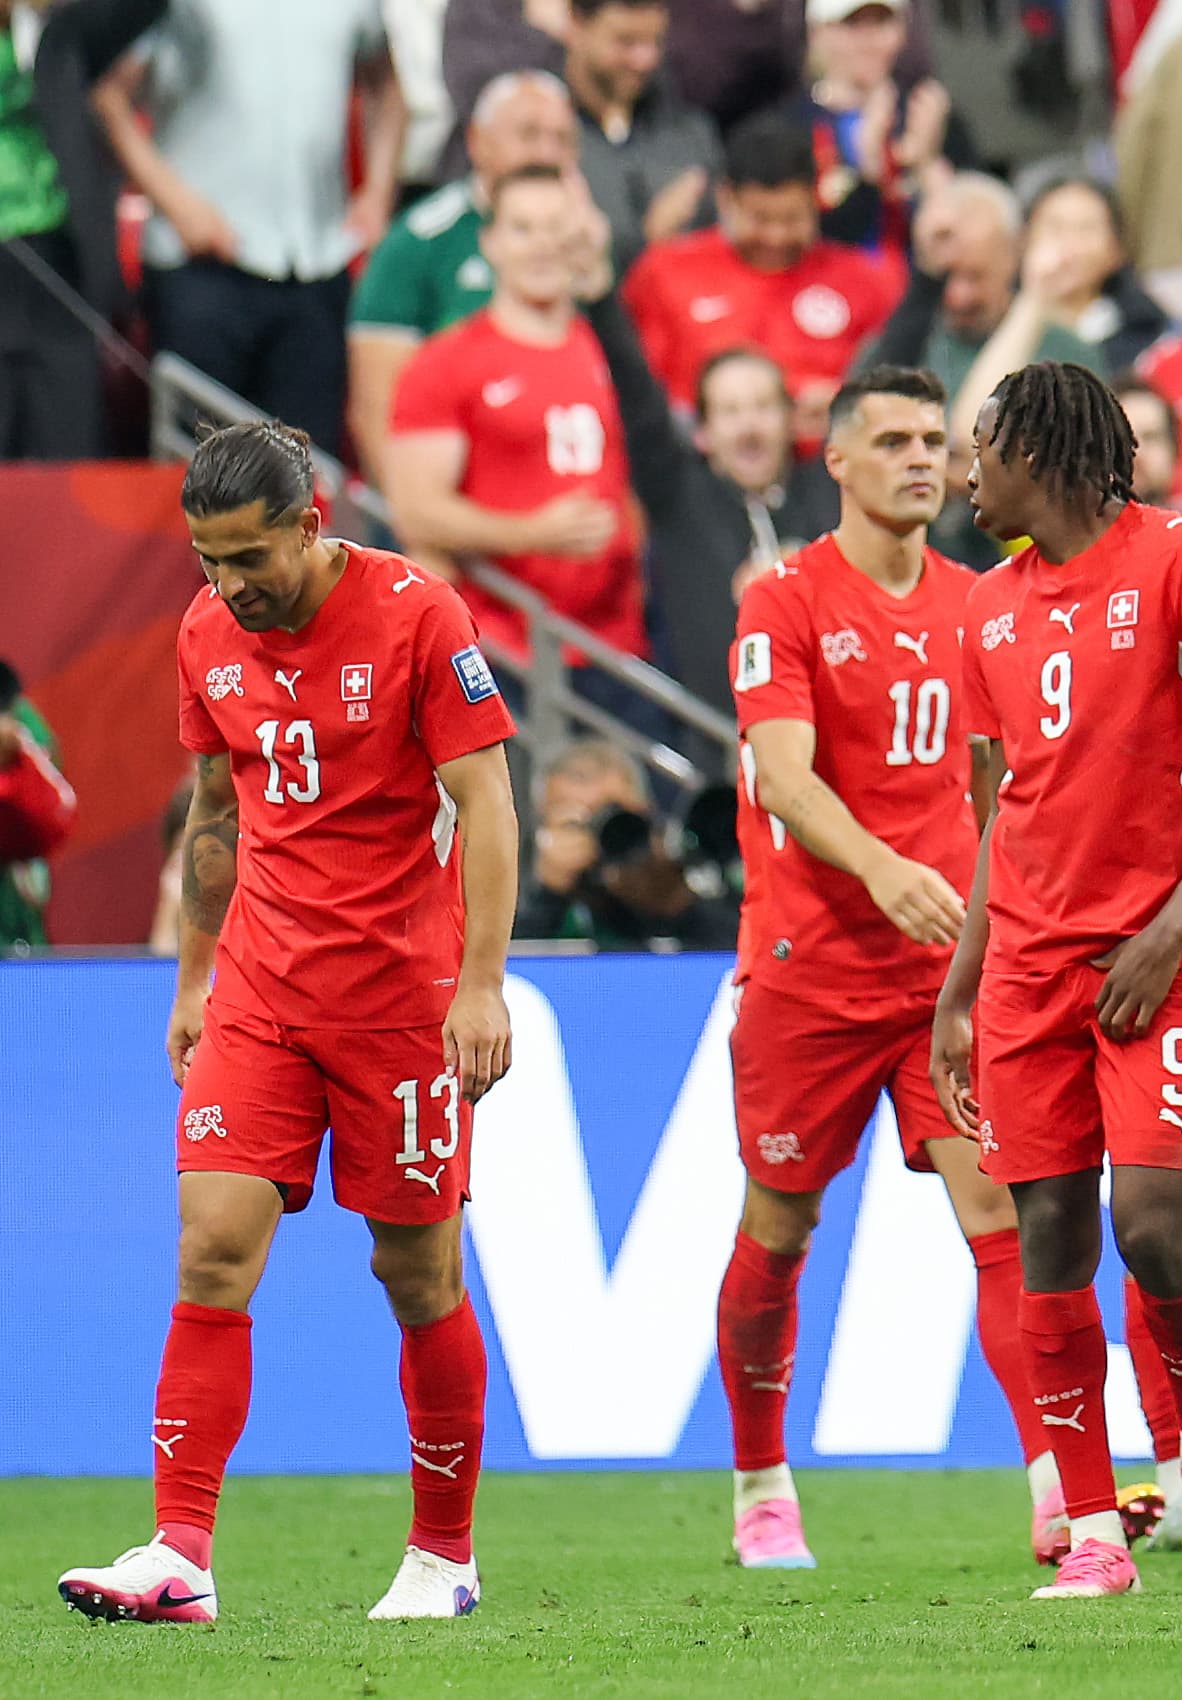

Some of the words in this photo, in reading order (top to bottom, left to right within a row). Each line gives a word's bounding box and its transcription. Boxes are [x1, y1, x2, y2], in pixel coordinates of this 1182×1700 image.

[886, 679, 950, 765] 10
[1040, 651, 1072, 739] 9
[256, 720, 321, 804] 13
[393, 1072, 459, 1164] 13
